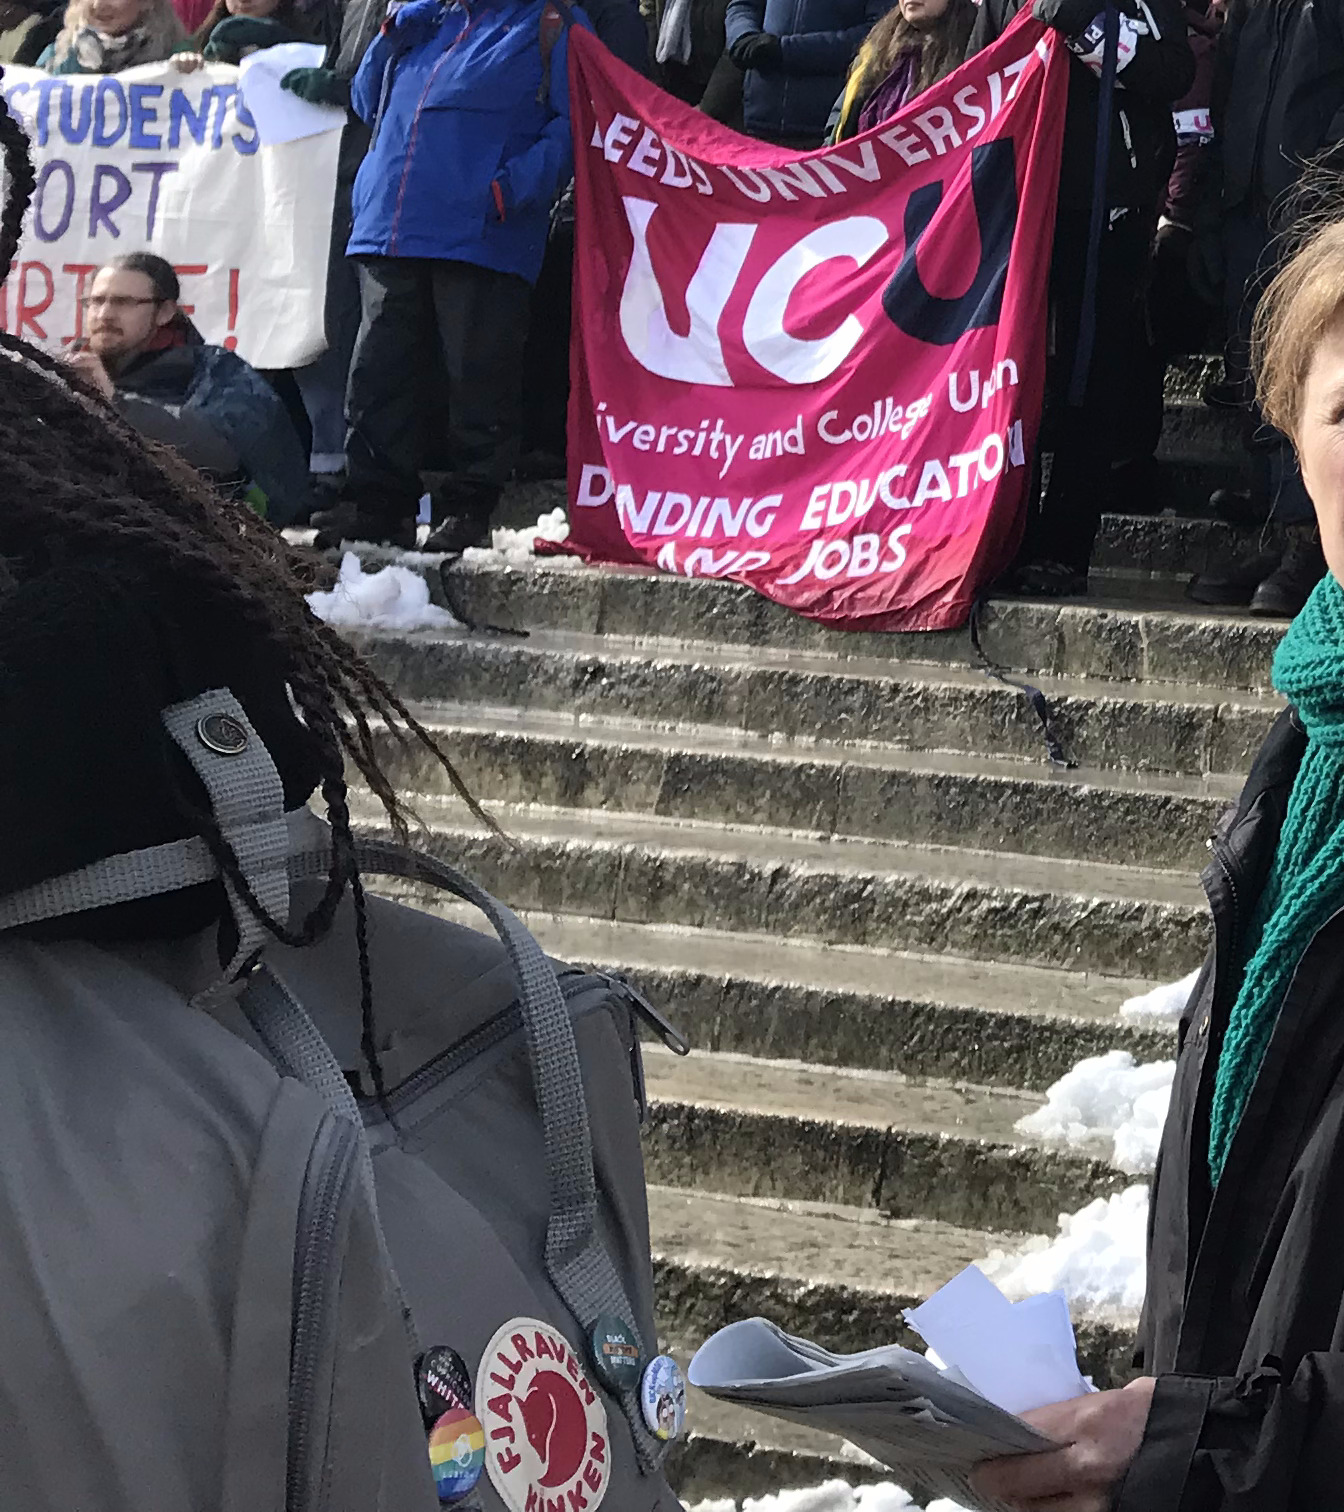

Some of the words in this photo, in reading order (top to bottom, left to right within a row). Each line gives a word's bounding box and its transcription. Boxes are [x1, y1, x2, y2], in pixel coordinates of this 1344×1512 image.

[718, 37, 1049, 203] UNIVERSIT
[34, 159, 180, 243] ORT
[618, 136, 1015, 388] UCU
[577, 463, 784, 539] DNDING
[800, 418, 1026, 532] EDUCATON
[595, 402, 745, 480] iversity
[749, 414, 804, 461] and
[777, 523, 913, 586] JOBS
